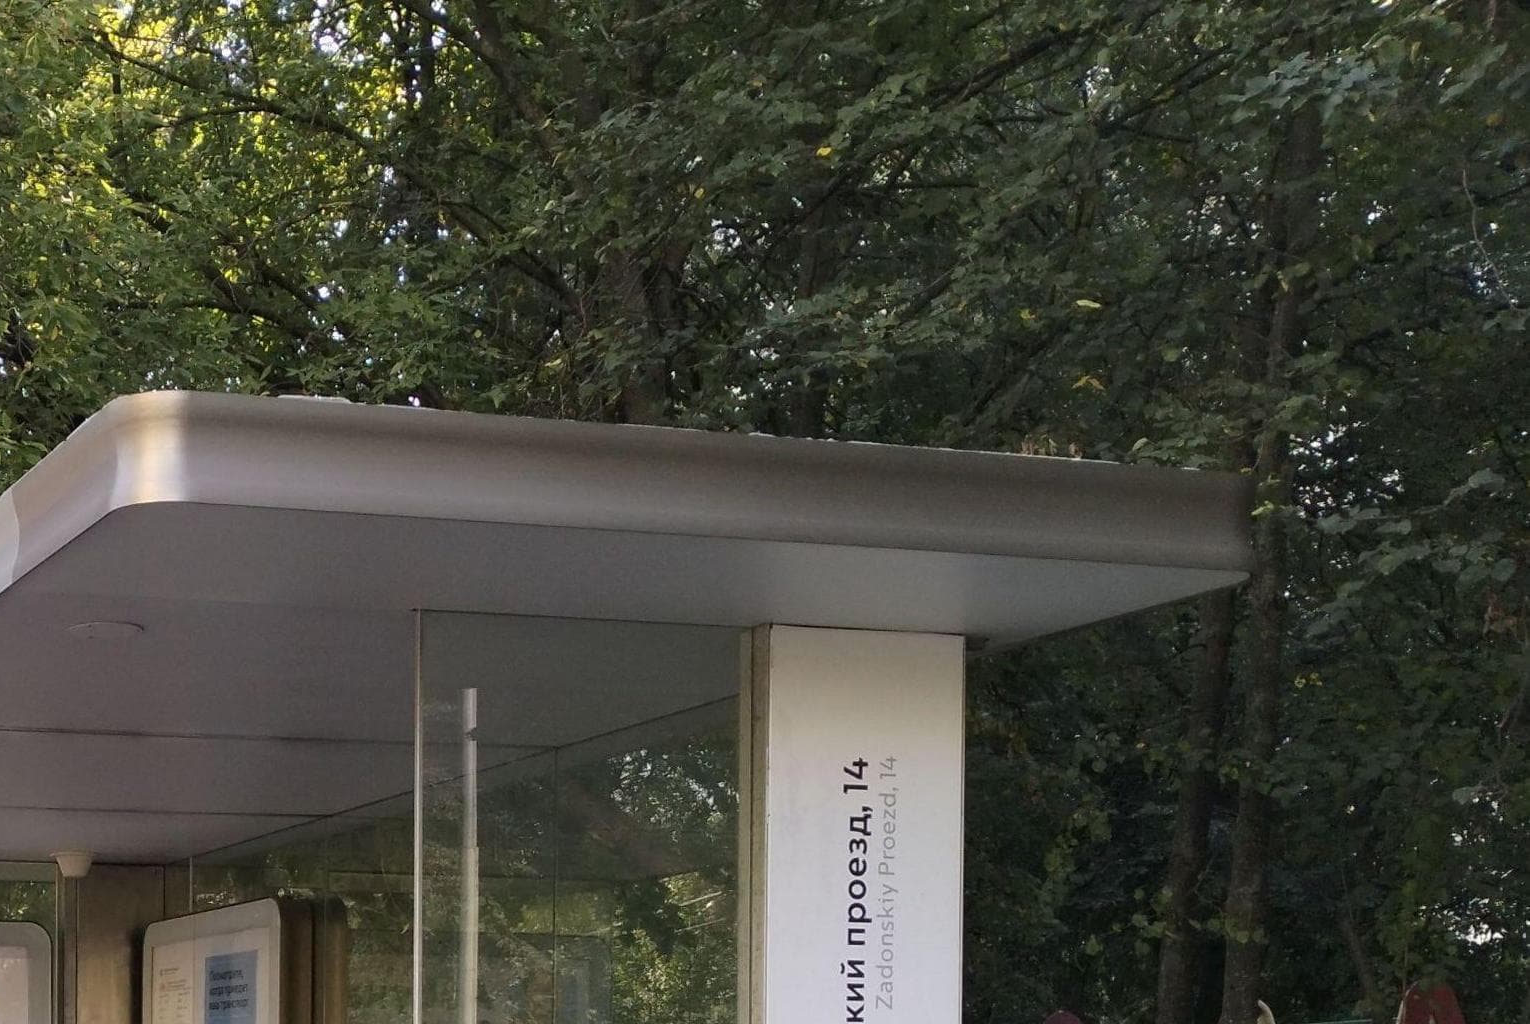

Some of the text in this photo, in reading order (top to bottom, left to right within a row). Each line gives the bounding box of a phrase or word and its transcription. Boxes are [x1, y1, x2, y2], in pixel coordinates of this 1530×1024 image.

[843, 757, 869, 794] 14
[846, 806, 872, 947] проезд,
[875, 755, 899, 1010] Zadonskiy Proezd, 14
